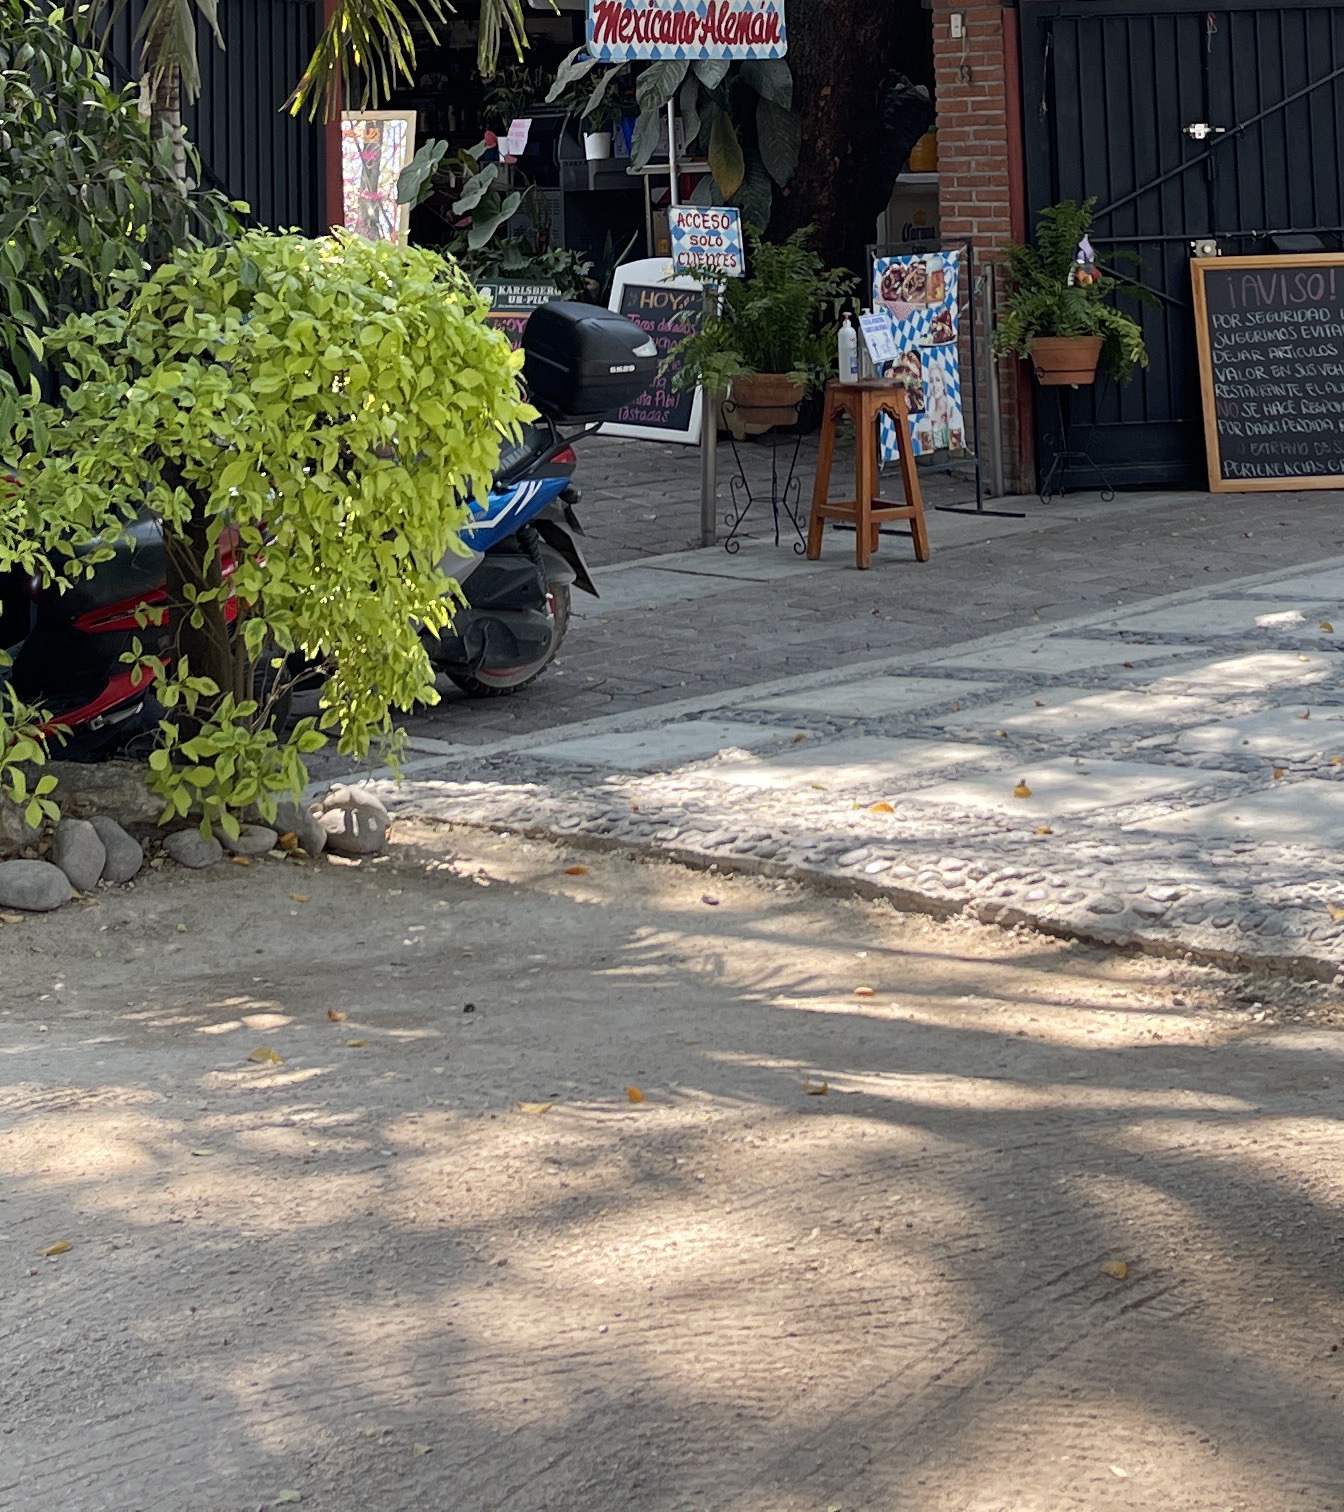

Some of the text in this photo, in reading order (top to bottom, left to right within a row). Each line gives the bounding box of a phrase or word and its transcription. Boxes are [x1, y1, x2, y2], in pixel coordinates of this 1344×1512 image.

[593, 0, 781, 45] Mexicano Alemán
[677, 212, 730, 230] ACCESO
[678, 251, 737, 268] CLIENTES
[1212, 313, 1242, 329] POR
[1245, 307, 1331, 326] SEGURIDAD
[1213, 325, 1297, 349] SUGERIMOS
[1212, 349, 1265, 364] DEJAR
[1214, 365, 1270, 382] VALOR
[1270, 364, 1292, 378] EN
[1294, 362, 1317, 378] SUS
[1214, 383, 1304, 399] RESTAURANTE
[1307, 384, 1325, 397] EL
[1217, 401, 1239, 418] NO
[1241, 402, 1261, 418] SE
[1263, 400, 1297, 416] HACE
[1218, 419, 1244, 437] POR
